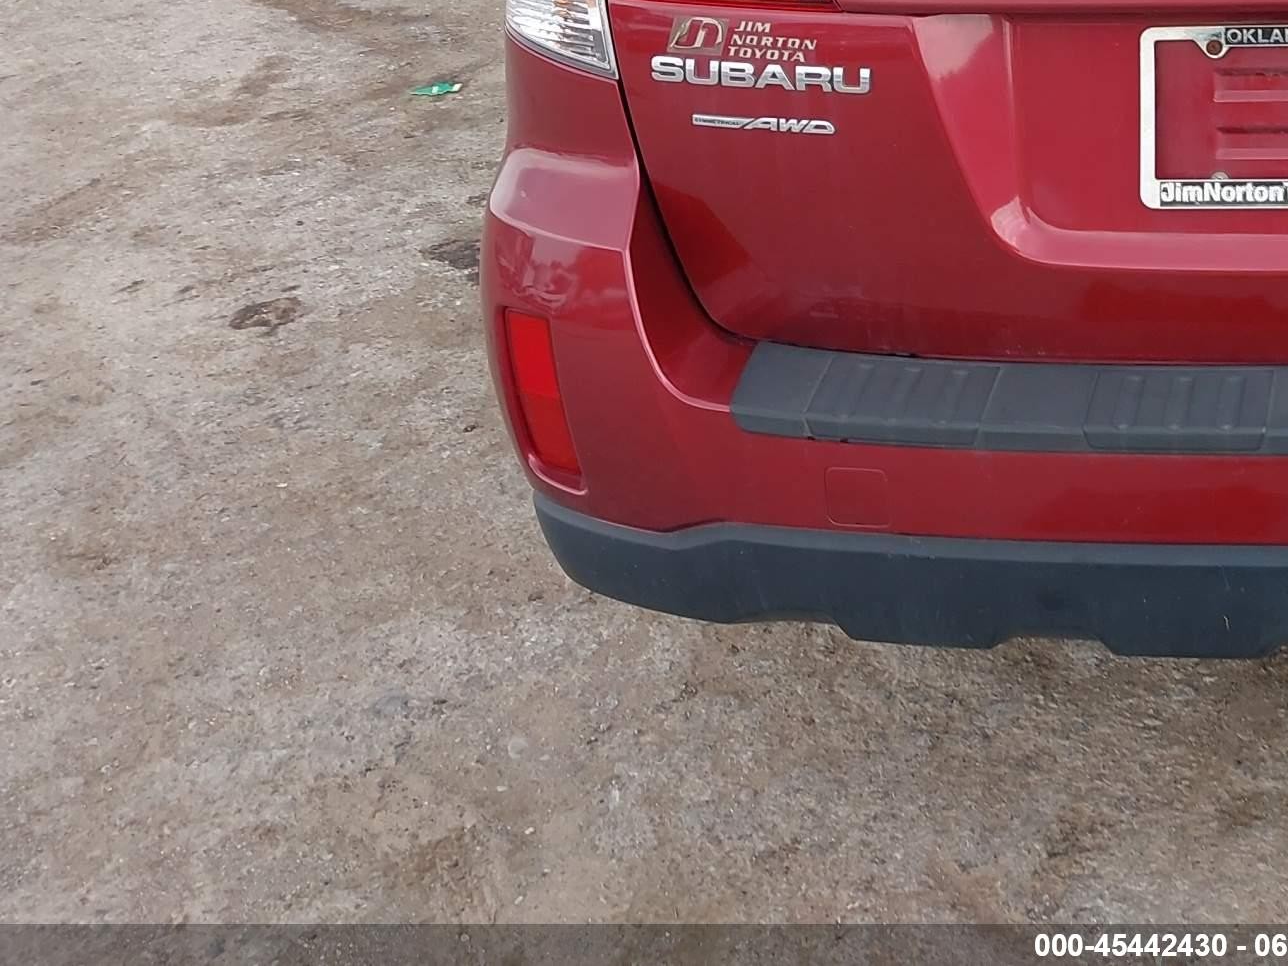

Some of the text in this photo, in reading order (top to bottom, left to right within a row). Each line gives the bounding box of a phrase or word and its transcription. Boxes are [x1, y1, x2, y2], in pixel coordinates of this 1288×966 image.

[734, 21, 771, 33] JIM
[730, 34, 817, 50] NORTON
[727, 45, 806, 63] TOYOTA
[651, 55, 871, 95] SUBARU
[744, 117, 836, 134] AWD
